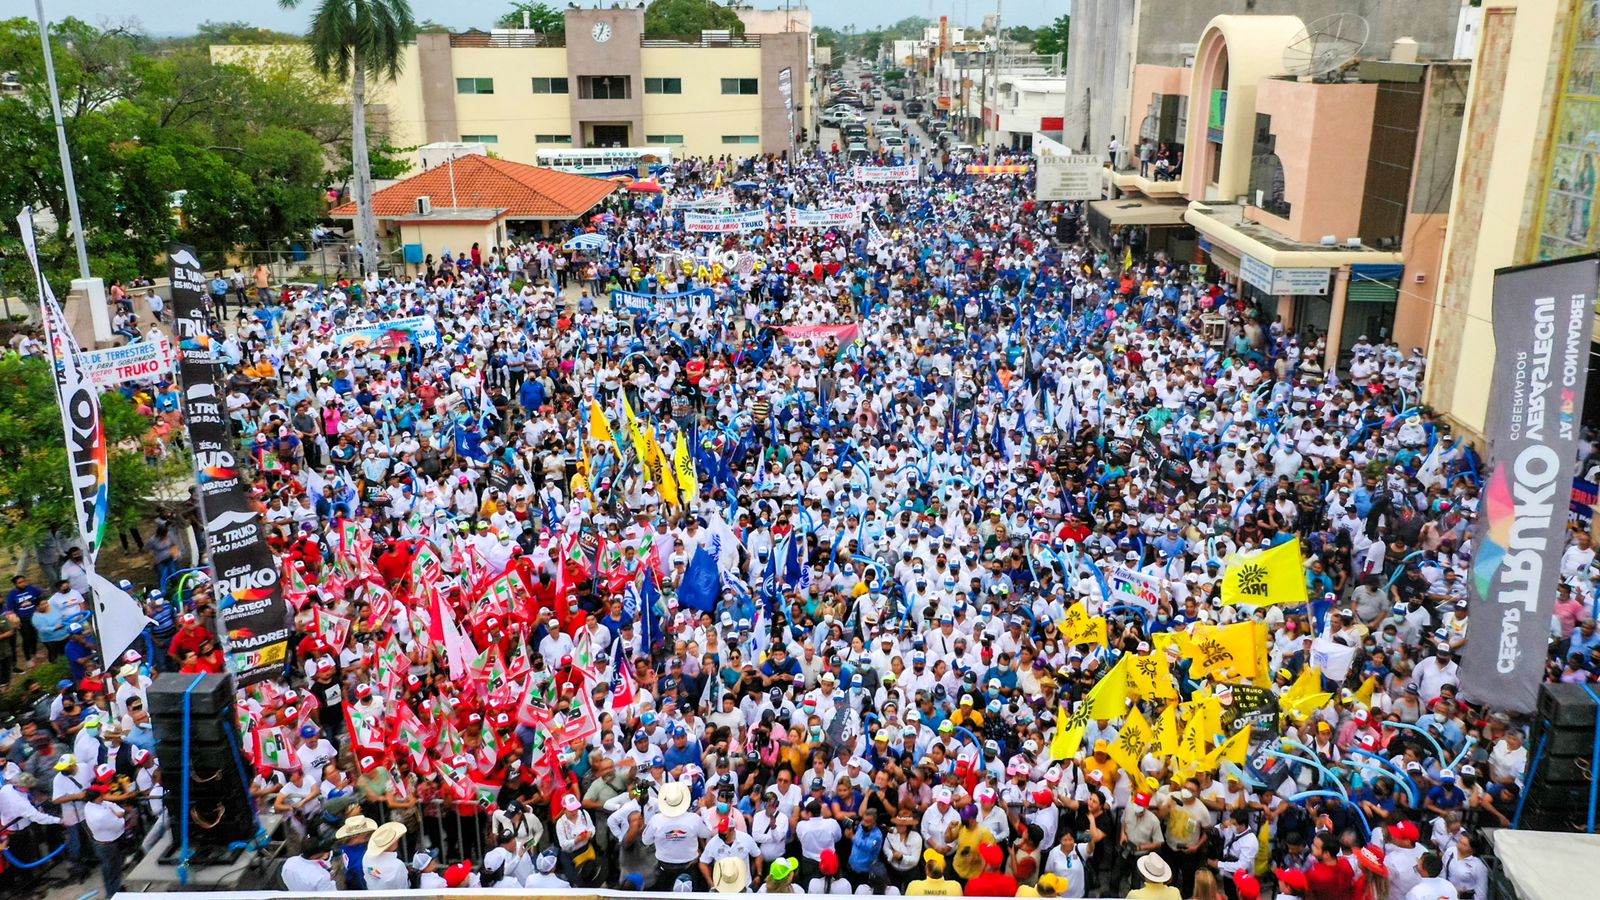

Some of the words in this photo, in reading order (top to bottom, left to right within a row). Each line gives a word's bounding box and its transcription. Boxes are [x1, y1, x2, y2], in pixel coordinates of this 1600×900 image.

[1043, 156, 1098, 164] DENTISTA
[174, 268, 186, 279] EL
[92, 354, 101, 363] DE
[105, 344, 155, 360] TERRESTRES
[96, 362, 113, 370] PARA
[116, 360, 159, 379] TRUKO
[223, 523, 258, 543] TRUKO
[216, 544, 230, 554] NO
[224, 564, 251, 578] CÉSAR
[214, 567, 277, 598] RUKO
